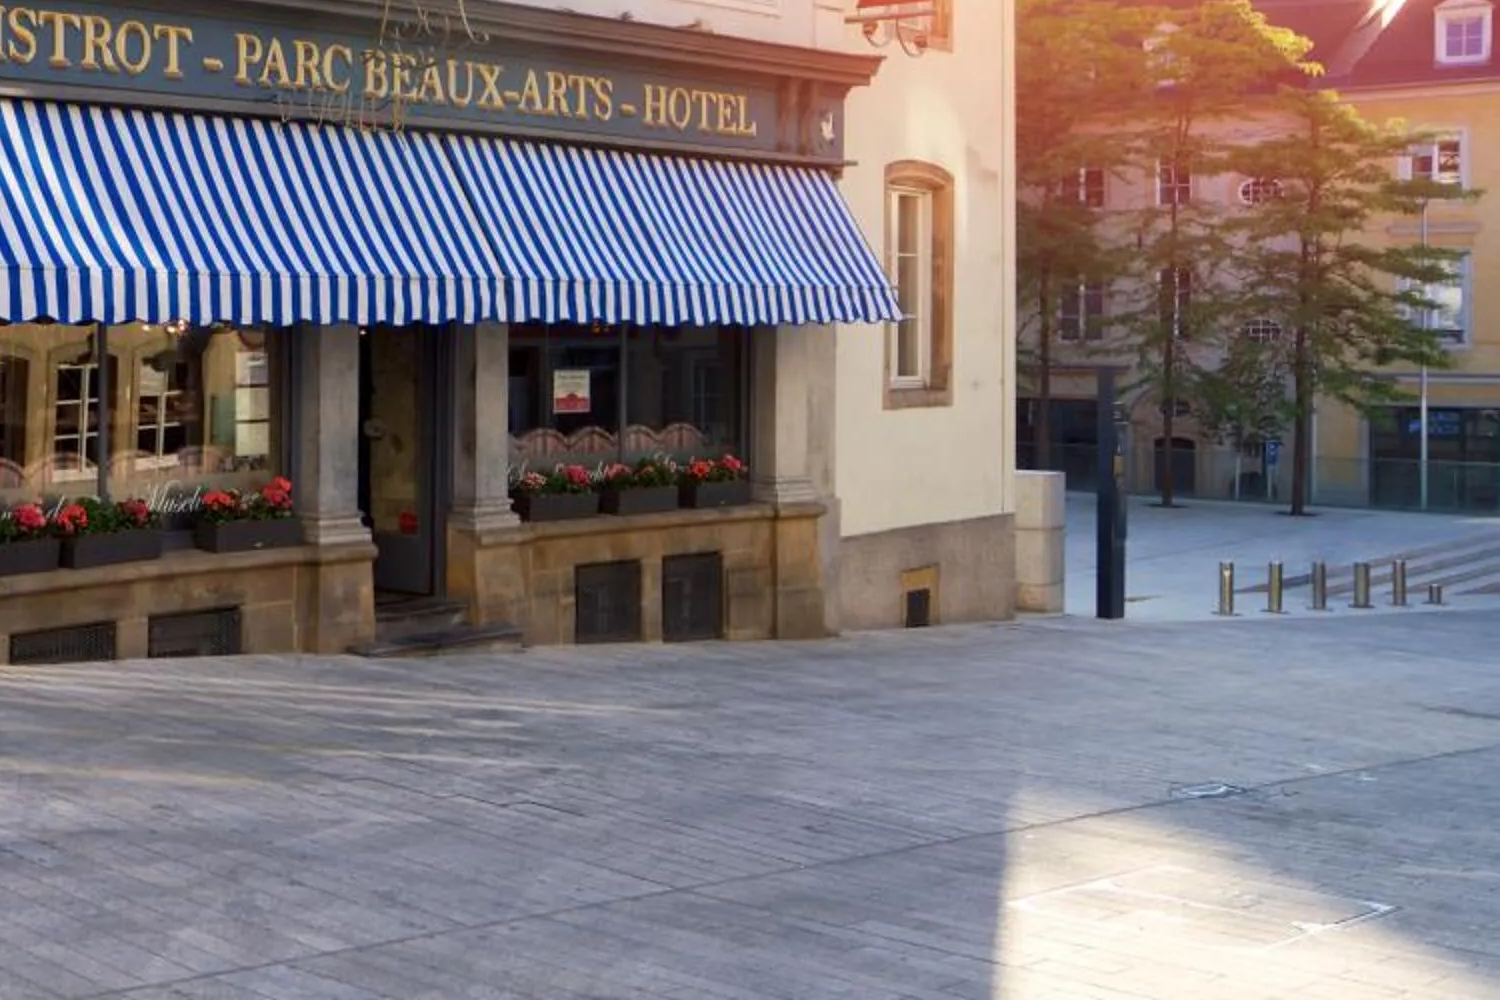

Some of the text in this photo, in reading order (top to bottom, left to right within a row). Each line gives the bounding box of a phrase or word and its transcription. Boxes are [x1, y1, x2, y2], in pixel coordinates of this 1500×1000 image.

[235, 32, 353, 93] PARC
[362, 48, 614, 122] BEAUX-ARTS
[643, 83, 758, 138] HOTEL
